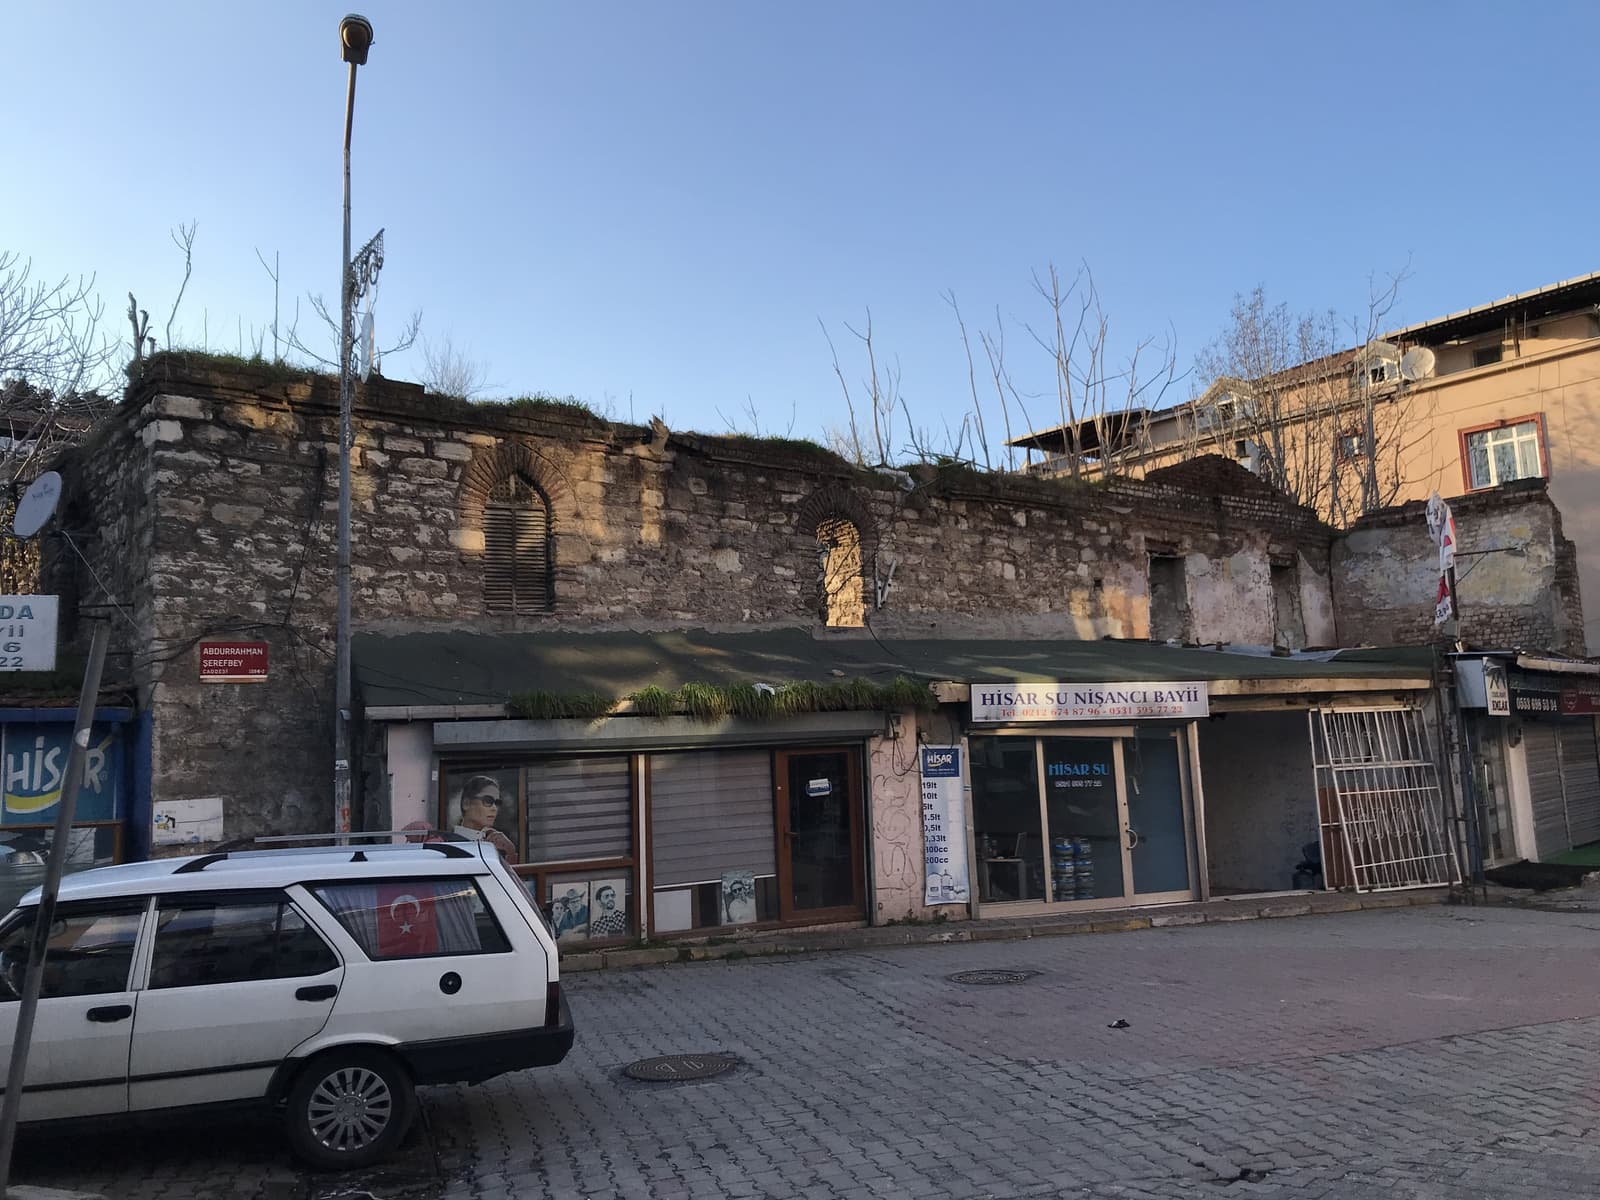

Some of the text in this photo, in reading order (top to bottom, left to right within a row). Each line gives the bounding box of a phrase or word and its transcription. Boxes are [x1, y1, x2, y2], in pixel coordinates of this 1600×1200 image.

[203, 647, 263, 655] ABDURRAHMAN
[203, 659, 243, 668] ŞEREFBEY
[981, 687, 1198, 707] HİSAR SU NİŞANCI BAYİİ
[1051, 708, 1069, 717] 674
[1072, 707, 1085, 716] 87
[1087, 707, 1100, 715] 96
[1109, 706, 1132, 715] 0531
[1156, 705, 1169, 713] 77
[1170, 705, 1183, 714] 22
[6, 735, 103, 795] HİSR
[926, 751, 953, 765] HİSAR
[1048, 760, 1110, 777] HİSAR SU
